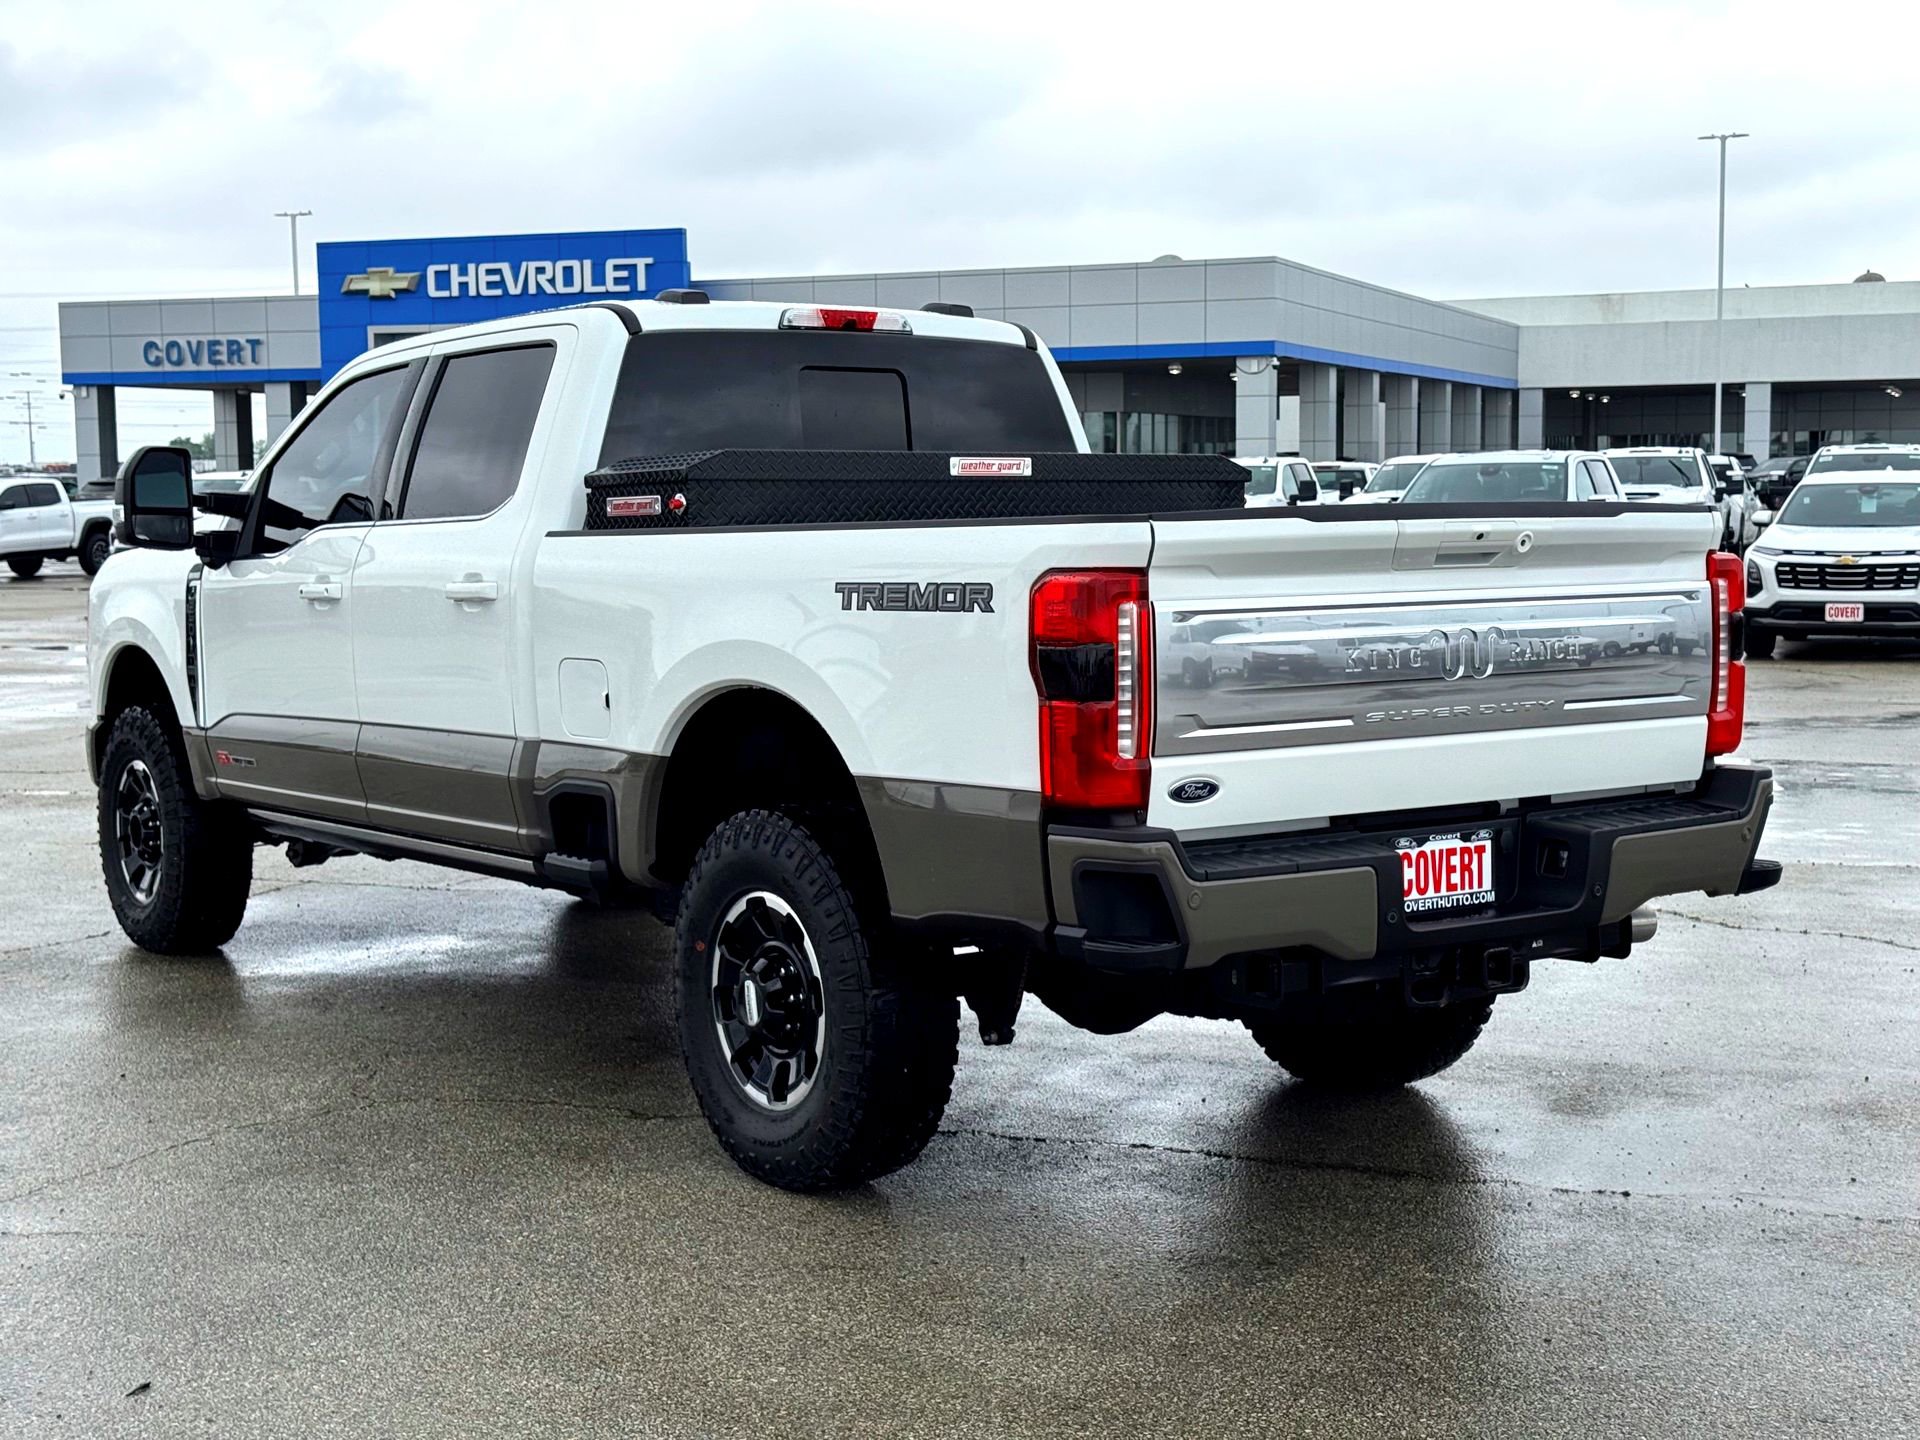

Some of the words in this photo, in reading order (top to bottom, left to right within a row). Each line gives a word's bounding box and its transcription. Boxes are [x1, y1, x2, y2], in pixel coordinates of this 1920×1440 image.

[426, 257, 654, 298] CHEVROLET
[143, 338, 263, 367] COVERT
[961, 461, 995, 471] weather
[997, 461, 1022, 472] guard
[835, 582, 995, 613] TREMOR
[1828, 606, 1860, 618] COVERT
[1345, 647, 1423, 673] KING
[1508, 638, 1586, 663] RANCH
[1365, 705, 1472, 724] SUPER
[1479, 699, 1555, 716] DUTY
[1181, 782, 1211, 798] Ford
[1429, 832, 1461, 841] Covert
[1400, 844, 1486, 898] COVERT
[1404, 891, 1496, 913] OVERTHUTTO.COM
